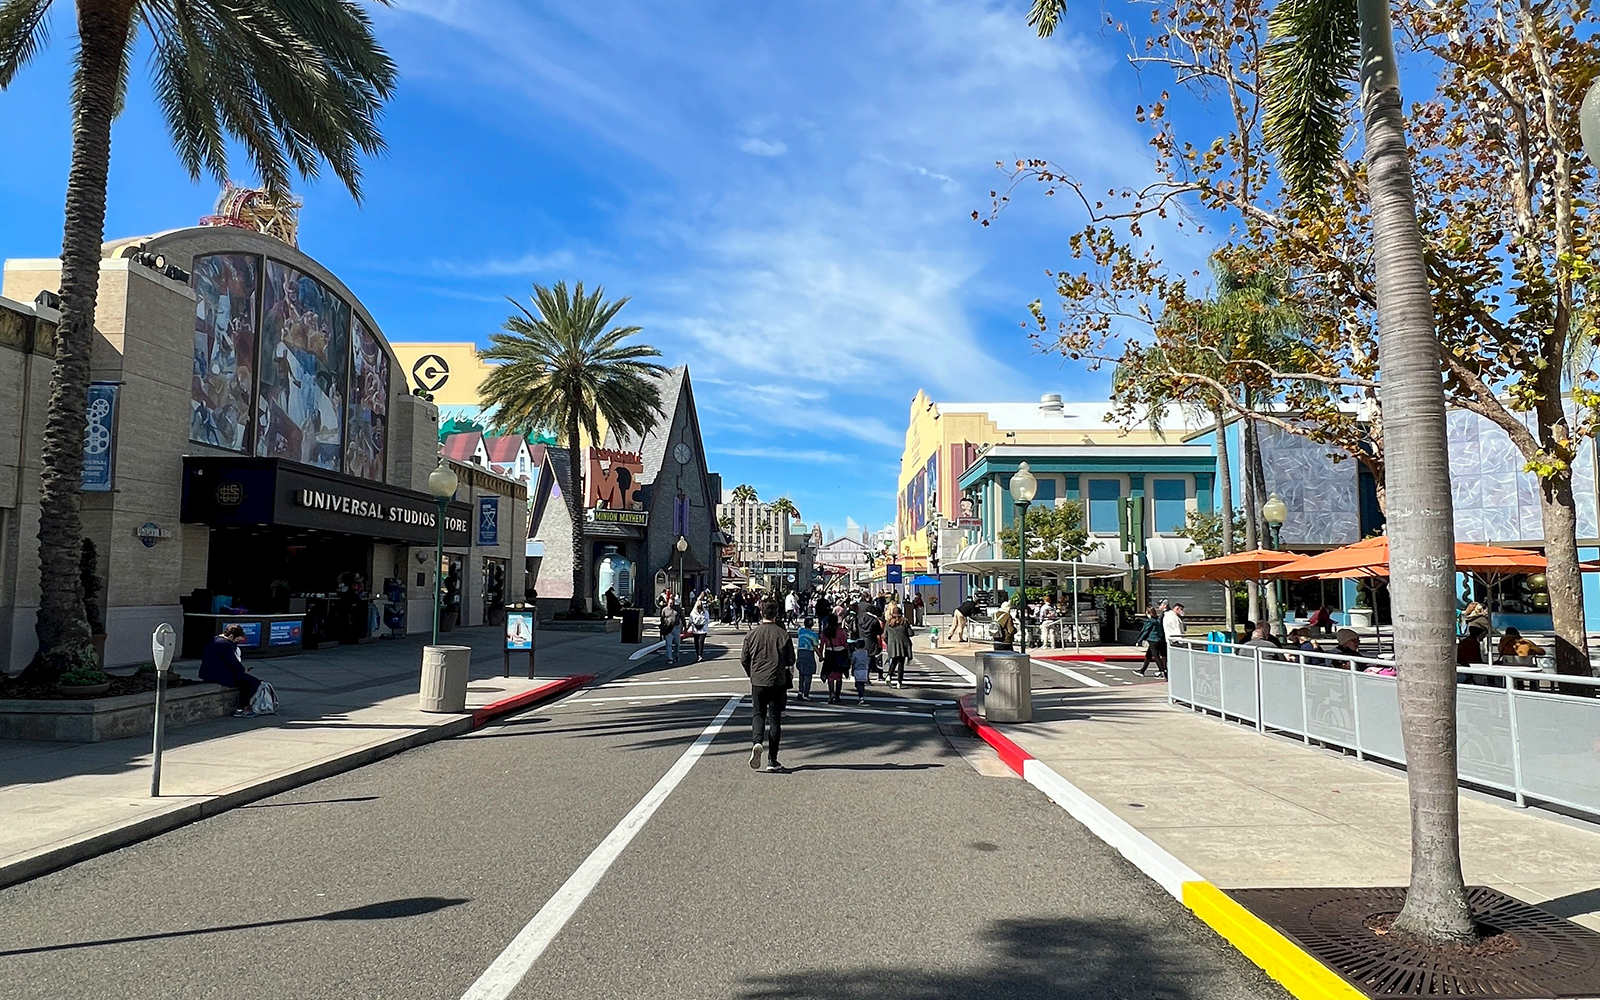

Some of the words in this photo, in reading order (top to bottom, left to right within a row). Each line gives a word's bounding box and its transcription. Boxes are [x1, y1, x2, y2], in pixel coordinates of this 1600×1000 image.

[303, 489, 384, 519] UNIVERSAL
[388, 506, 436, 528] STUDIOS
[444, 515, 467, 533] TORE
[595, 511, 618, 522] MINION
[619, 514, 645, 524] MAYHEM
